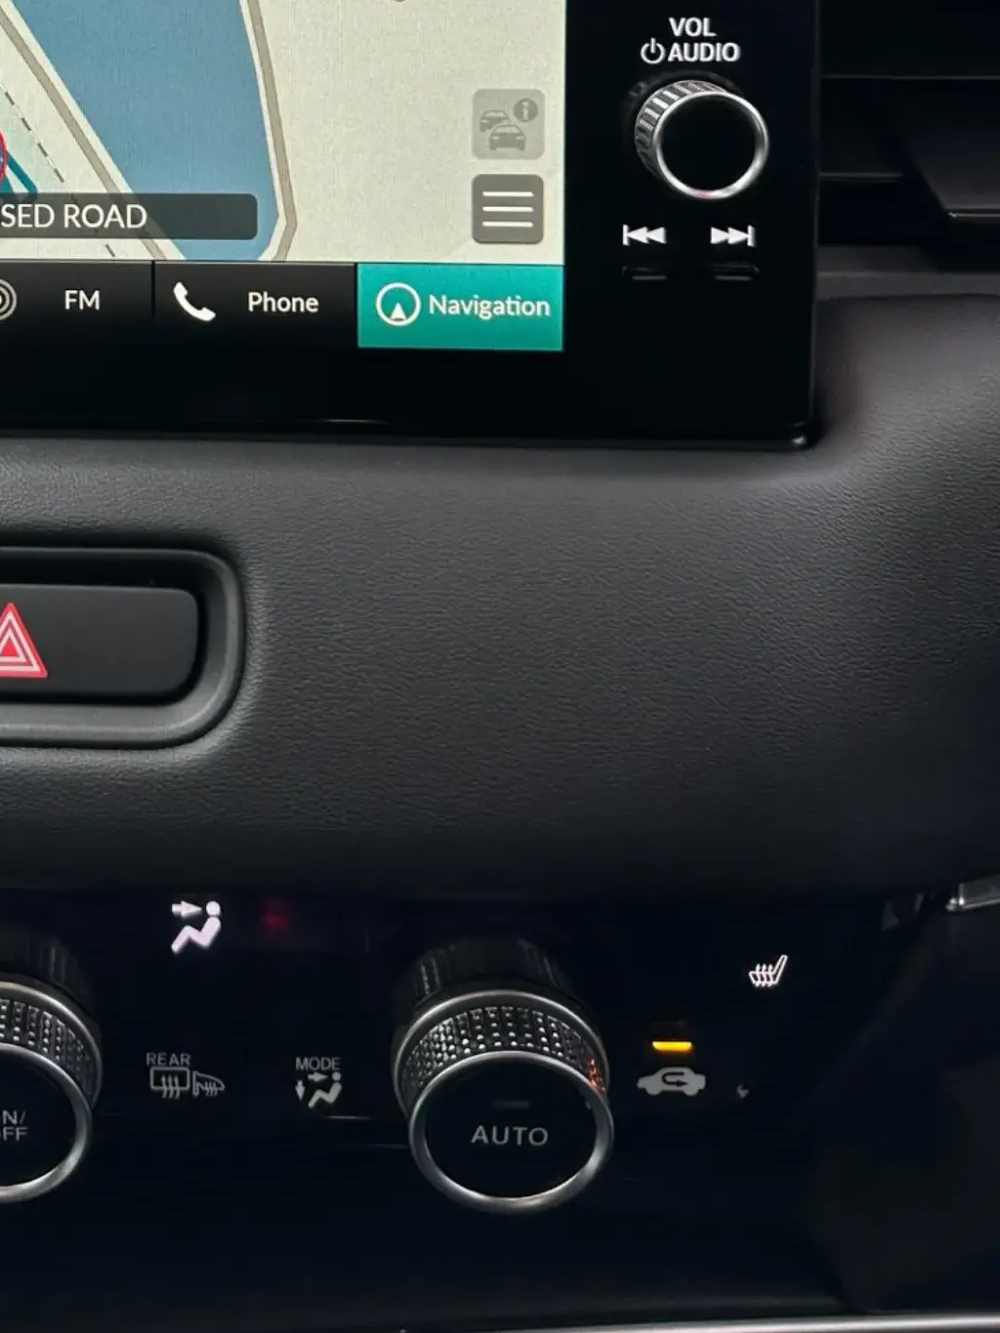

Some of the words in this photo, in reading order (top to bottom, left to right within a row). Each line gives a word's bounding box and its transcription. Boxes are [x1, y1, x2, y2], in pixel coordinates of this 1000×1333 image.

[668, 16, 717, 37] VOL
[667, 42, 740, 63] AUDIO
[63, 203, 148, 229] ROAD
[64, 289, 100, 311] FM
[248, 290, 320, 313] Phone
[429, 294, 551, 321] Navigation
[145, 1052, 191, 1067] REAR
[295, 1056, 340, 1071] MODE
[470, 1124, 549, 1146] AUTO
